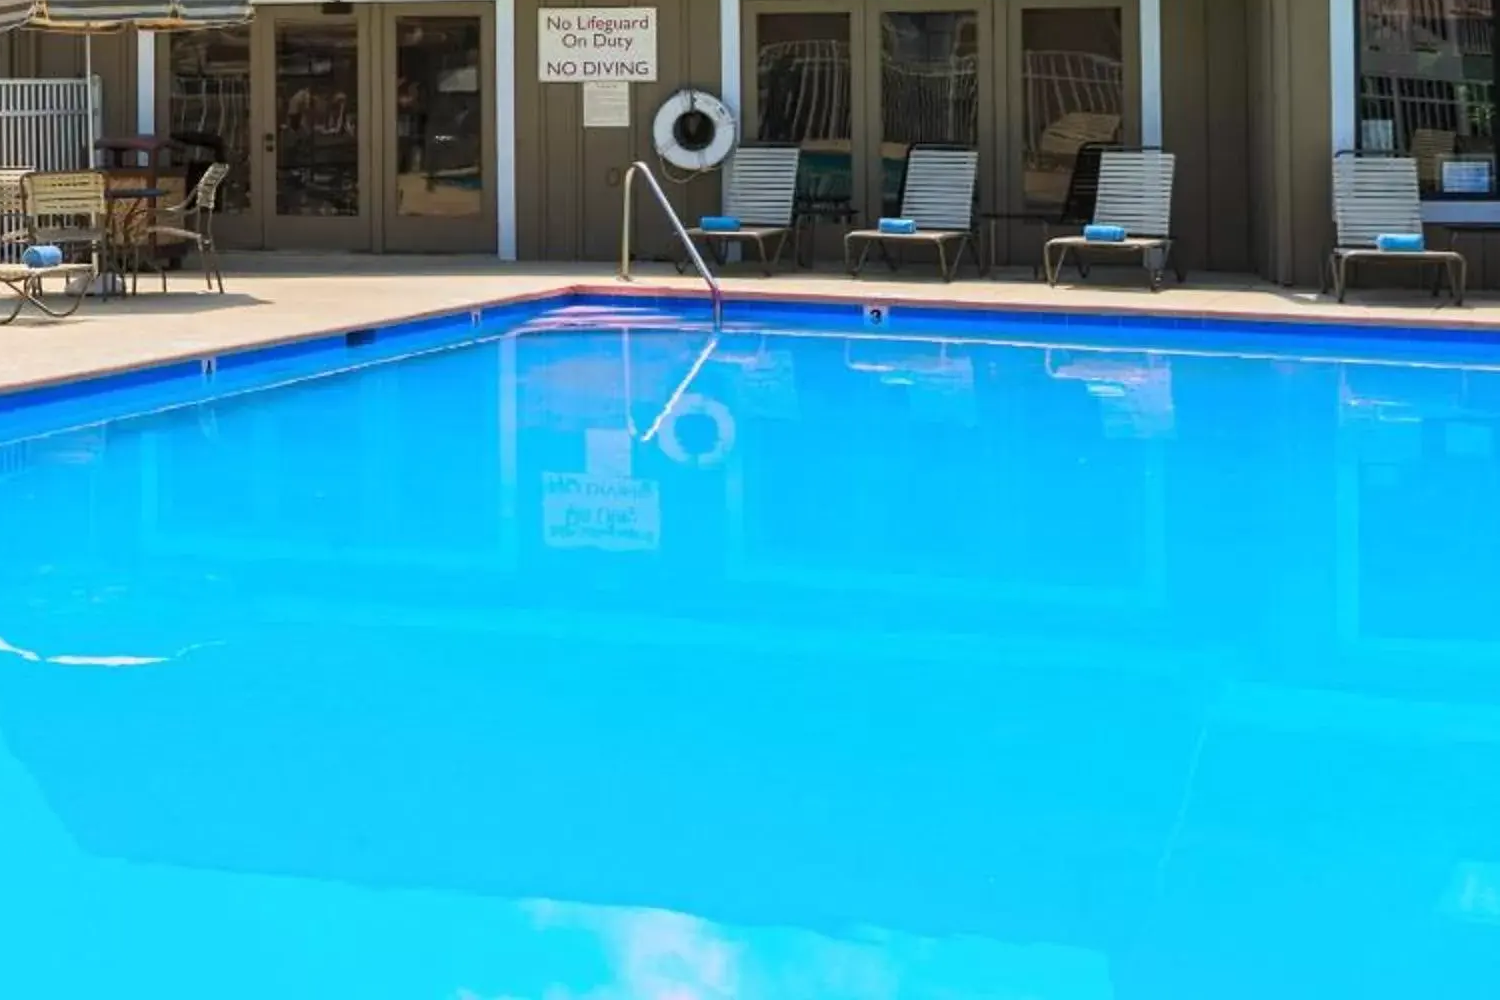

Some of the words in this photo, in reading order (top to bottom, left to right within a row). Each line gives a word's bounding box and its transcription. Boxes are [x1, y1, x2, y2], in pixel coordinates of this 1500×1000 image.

[546, 15, 572, 31] No
[577, 15, 649, 34] Lifeguard
[562, 33, 587, 49] On
[593, 33, 633, 51] Duty
[547, 61, 577, 76] NO
[583, 61, 649, 77] DIVING
